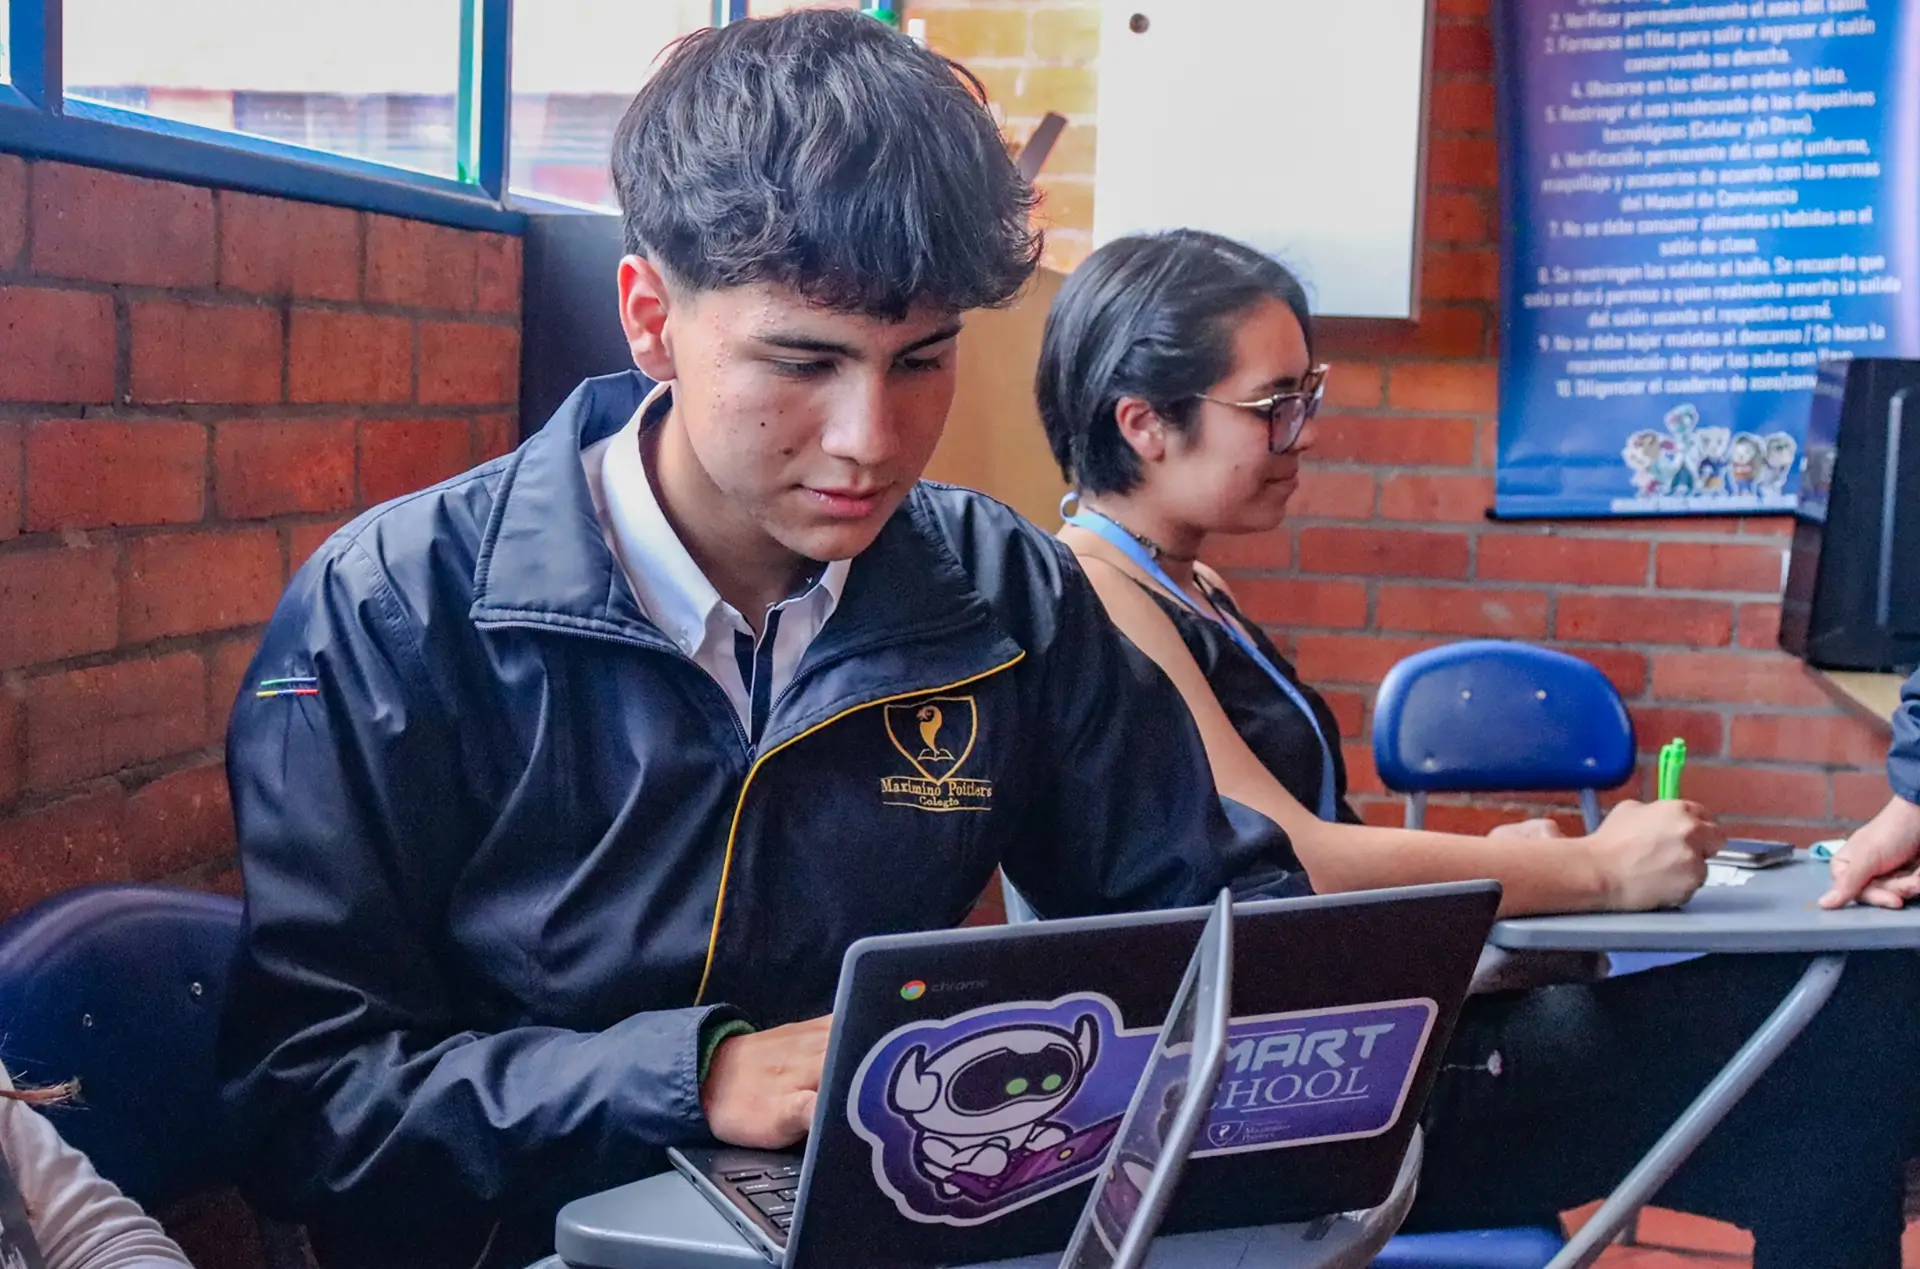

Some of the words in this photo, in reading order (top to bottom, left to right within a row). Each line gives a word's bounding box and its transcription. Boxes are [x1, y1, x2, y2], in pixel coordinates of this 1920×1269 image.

[1624, 34, 1643, 49] en
[1644, 29, 1676, 48] filas
[1676, 30, 1711, 50] para
[1712, 25, 1744, 45] salir
[1758, 23, 1817, 45] ingresar
[1818, 19, 1835, 37] al
[1646, 80, 1665, 95] en
[1792, 67, 1811, 86] de
[1627, 100, 1643, 119] el
[1644, 103, 1670, 118] uso
[1750, 94, 1769, 112] de
[1770, 93, 1793, 111] los
[1794, 88, 1876, 112] dispositivos
[1564, 146, 1644, 168] Verificación
[1728, 140, 1751, 161] del
[1752, 143, 1779, 158] uso
[1780, 139, 1803, 158] del
[1613, 175, 1624, 194] y
[1625, 169, 1697, 189] accesorios
[1699, 167, 1717, 185] de
[1775, 165, 1801, 181] con
[1802, 161, 1825, 180] las
[1827, 161, 1881, 179] normas
[1620, 194, 1643, 213] del
[1644, 190, 1695, 211] Manual
[1697, 191, 1715, 209] de
[1562, 218, 1582, 237] No
[1583, 221, 1600, 238] se
[1602, 217, 1635, 237] debe
[1636, 217, 1698, 235] consumir
[1701, 213, 1769, 232] alimentos
[1781, 208, 1836, 228] bebidas
[1837, 209, 1856, 225] en
[1857, 205, 1873, 224] el
[1699, 237, 1717, 256] de
[1552, 265, 1571, 284] Se
[1643, 262, 1666, 280] las
[1667, 260, 1717, 280] salidas
[1718, 259, 1733, 277] al
[1774, 255, 1793, 275] Se
[1794, 254, 1856, 274] recuerda
[1857, 255, 1886, 275] que
[1553, 293, 1570, 307] se
[1605, 287, 1660, 309] permiso
[1713, 281, 1784, 300] realmente
[1840, 276, 1856, 295] la
[1587, 309, 1610, 328] del
[1701, 306, 1716, 325] el
[1717, 303, 1789, 325] respectivo
[1573, 336, 1590, 352] se
[1592, 332, 1625, 351] debe
[1721, 328, 1737, 346] al
[1738, 326, 1802, 346] descanso
[1802, 322, 1812, 346] /
[1812, 323, 1832, 343] Se
[1833, 322, 1868, 342] hace
[1869, 321, 1886, 341] la
[1669, 353, 1687, 371] de
[1688, 351, 1724, 373] dejar
[1725, 351, 1749, 369] las
[1751, 349, 1789, 368] aulas
[1790, 351, 1816, 367] con
[1648, 376, 1663, 394] el
[1729, 373, 1747, 392] de
[881, 779, 941, 797] Maximino
[948, 781, 992, 797] Poitiers
[919, 796, 960, 809] Colegio
[1226, 1023, 1395, 1074] MART
[1211, 1066, 1369, 1109] HOOL
